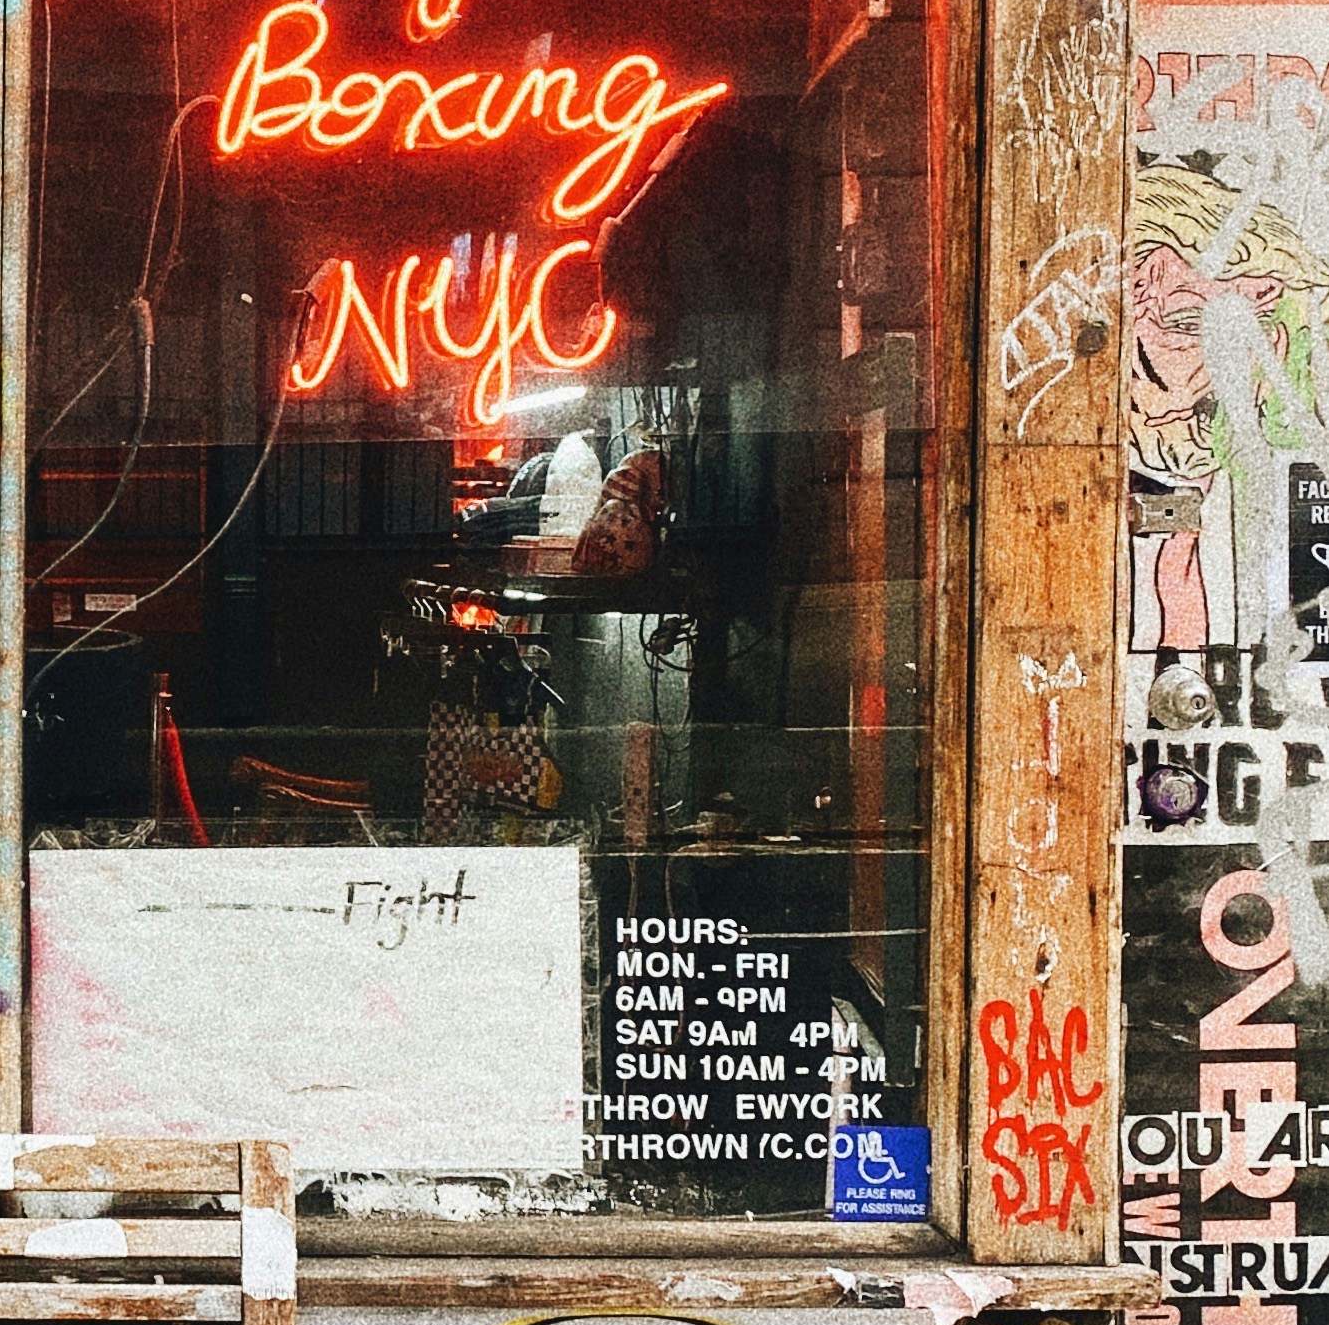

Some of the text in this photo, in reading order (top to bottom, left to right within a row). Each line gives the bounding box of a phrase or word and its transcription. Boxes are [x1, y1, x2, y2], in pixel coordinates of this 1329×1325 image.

[215, 0, 728, 219] Boxing
[343, 868, 477, 951] Fight
[615, 917, 749, 946] HOURS:
[616, 951, 705, 980] MON.
[736, 952, 790, 979] FRI
[614, 985, 685, 1012] 6AM
[615, 1020, 859, 1049] SAT 9AM 4PM
[614, 1053, 687, 1081] SUN
[699, 1054, 786, 1082] 10AM
[817, 1056, 887, 1083] 4PM
[835, 1201, 926, 1215] FOR ASSISTANCE
[846, 1187, 916, 1200] PLEASE RING
